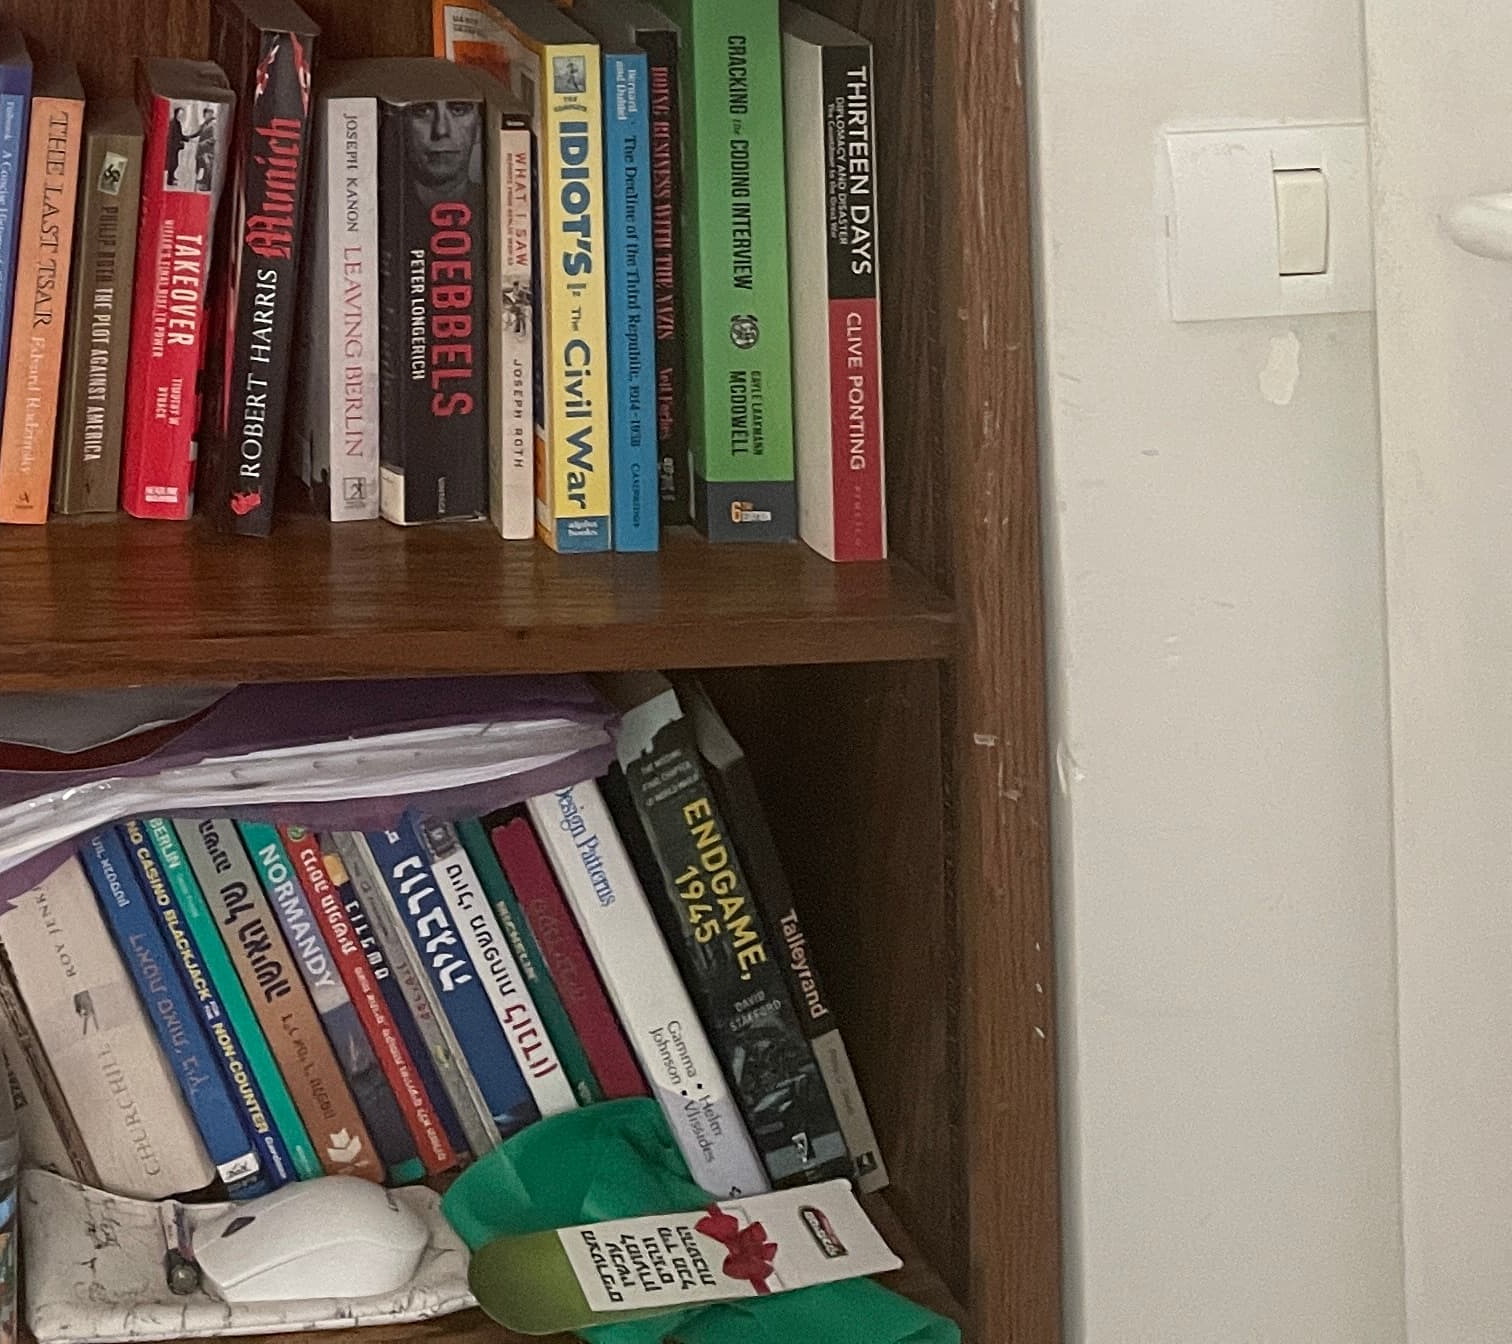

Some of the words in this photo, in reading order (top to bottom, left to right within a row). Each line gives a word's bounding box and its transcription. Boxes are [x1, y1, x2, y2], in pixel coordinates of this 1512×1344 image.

[728, 35, 747, 115] CRACKING
[730, 140, 749, 198] CODING
[846, 65, 869, 198] THIRTEEN
[411, 250, 424, 299] PETER
[729, 203, 752, 290] INTERVIEW
[849, 204, 871, 276] DAYS
[250, 268, 278, 365] HARRIS
[411, 303, 425, 381] LONGERICH
[430, 202, 472, 417] GOEBBELS
[846, 312, 864, 368] CLIVE
[512, 359, 524, 417] JOSEPH
[565, 340, 593, 418] Civil
[731, 370, 748, 456] MCDOWELL
[239, 376, 267, 478] ROBERT
[512, 429, 524, 468] ROTH
[849, 375, 865, 470] PONTING
[565, 425, 595, 510] War
[578, 833, 615, 907] Patterns
[675, 867, 720, 944] 1945
[683, 798, 766, 980] ENDGAME,
[259, 844, 335, 989] NORMANDY
[394, 857, 472, 990] נורבגיה
[137, 847, 169, 906] CASINO
[163, 908, 210, 1002] BLACKJACK
[214, 1023, 266, 1133] NON-COUNTER
[471, 917, 515, 995] משפחות
[504, 1002, 558, 1077] לונדון
[780, 909, 828, 1019] Talleyrand
[650, 1027, 681, 1084] Johnson
[667, 1020, 696, 1077] Gamma
